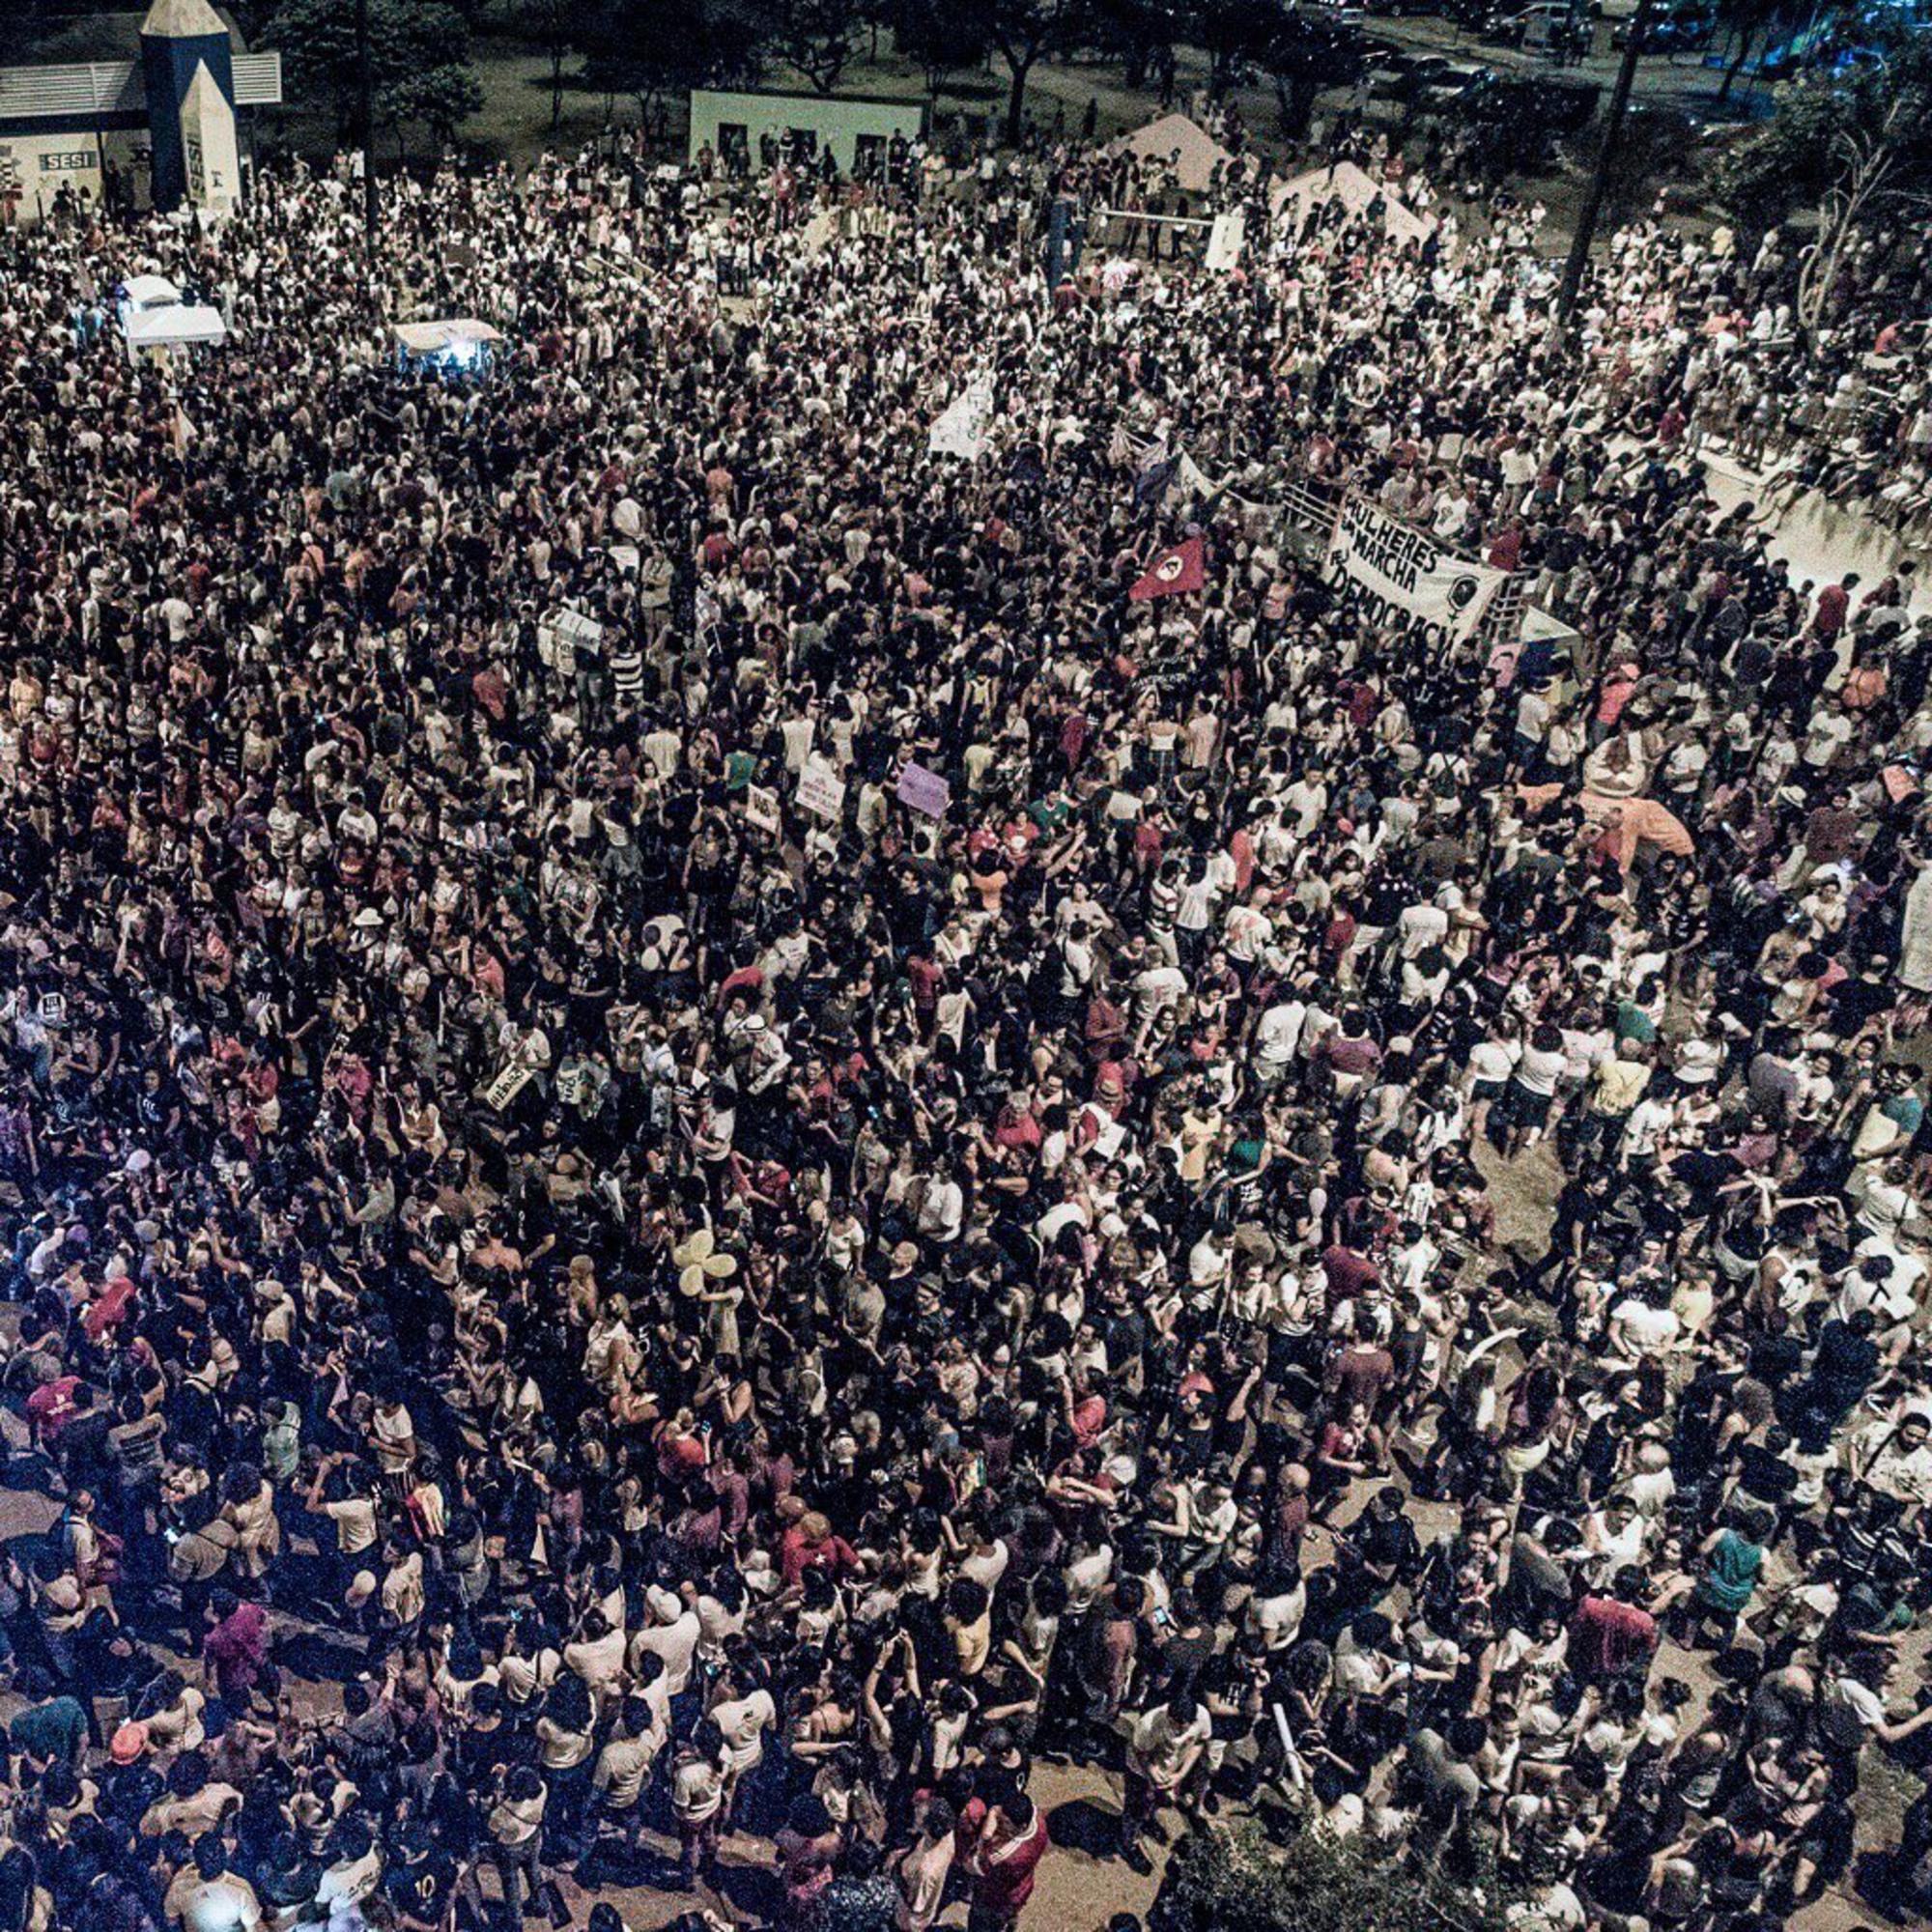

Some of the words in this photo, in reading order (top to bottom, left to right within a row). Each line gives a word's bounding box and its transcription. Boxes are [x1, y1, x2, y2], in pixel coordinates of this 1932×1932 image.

[47, 154, 88, 169] SESI
[1345, 494, 1441, 574] MULHERES
[1352, 530, 1417, 594] MARCHA
[414, 1874, 436, 1898] 10
